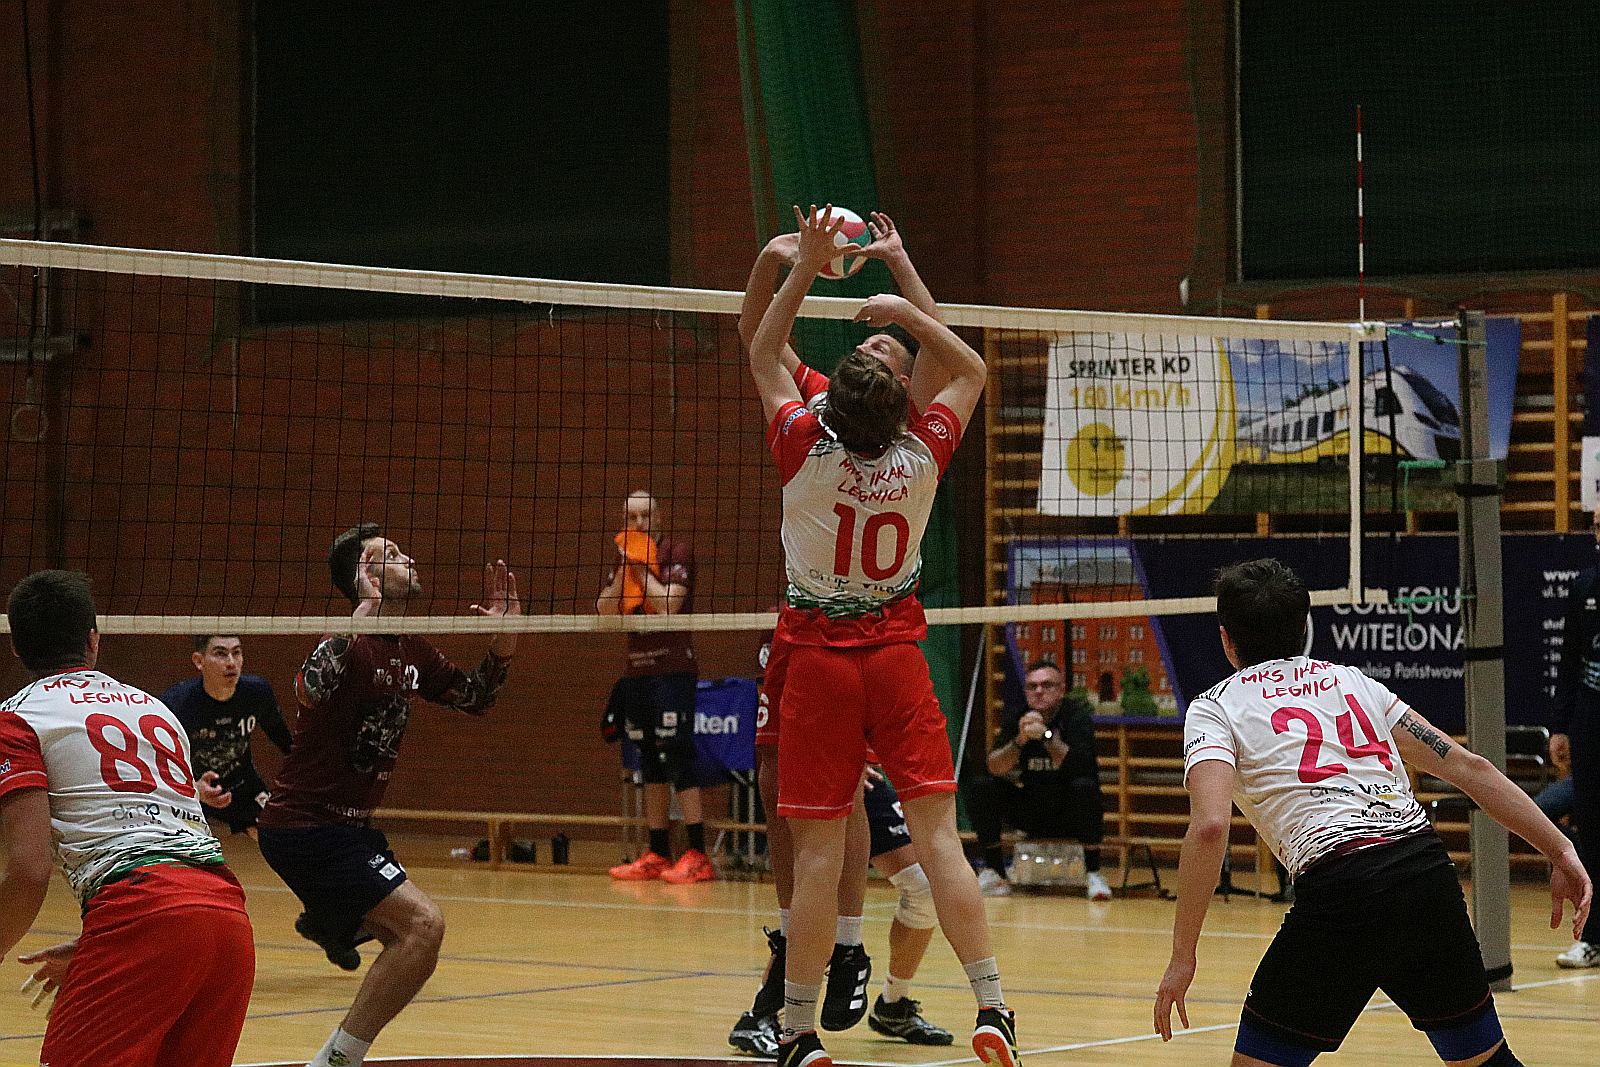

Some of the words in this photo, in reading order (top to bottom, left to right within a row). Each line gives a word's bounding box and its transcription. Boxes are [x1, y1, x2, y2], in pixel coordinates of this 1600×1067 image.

[1069, 358, 1156, 377] SPRINTER
[1164, 356, 1191, 374] KD
[870, 464, 912, 487] IKAR
[837, 480, 908, 505] LEGNICA
[833, 502, 910, 581] 10
[1331, 622, 1466, 651] WITELONA
[1241, 669, 1284, 684] MKS
[1395, 661, 1465, 679] Państwow
[69, 692, 155, 706] LEGNICA
[238, 714, 256, 737] 10
[694, 711, 740, 735] lten
[1271, 694, 1393, 783] 24
[85, 713, 197, 798] 88
